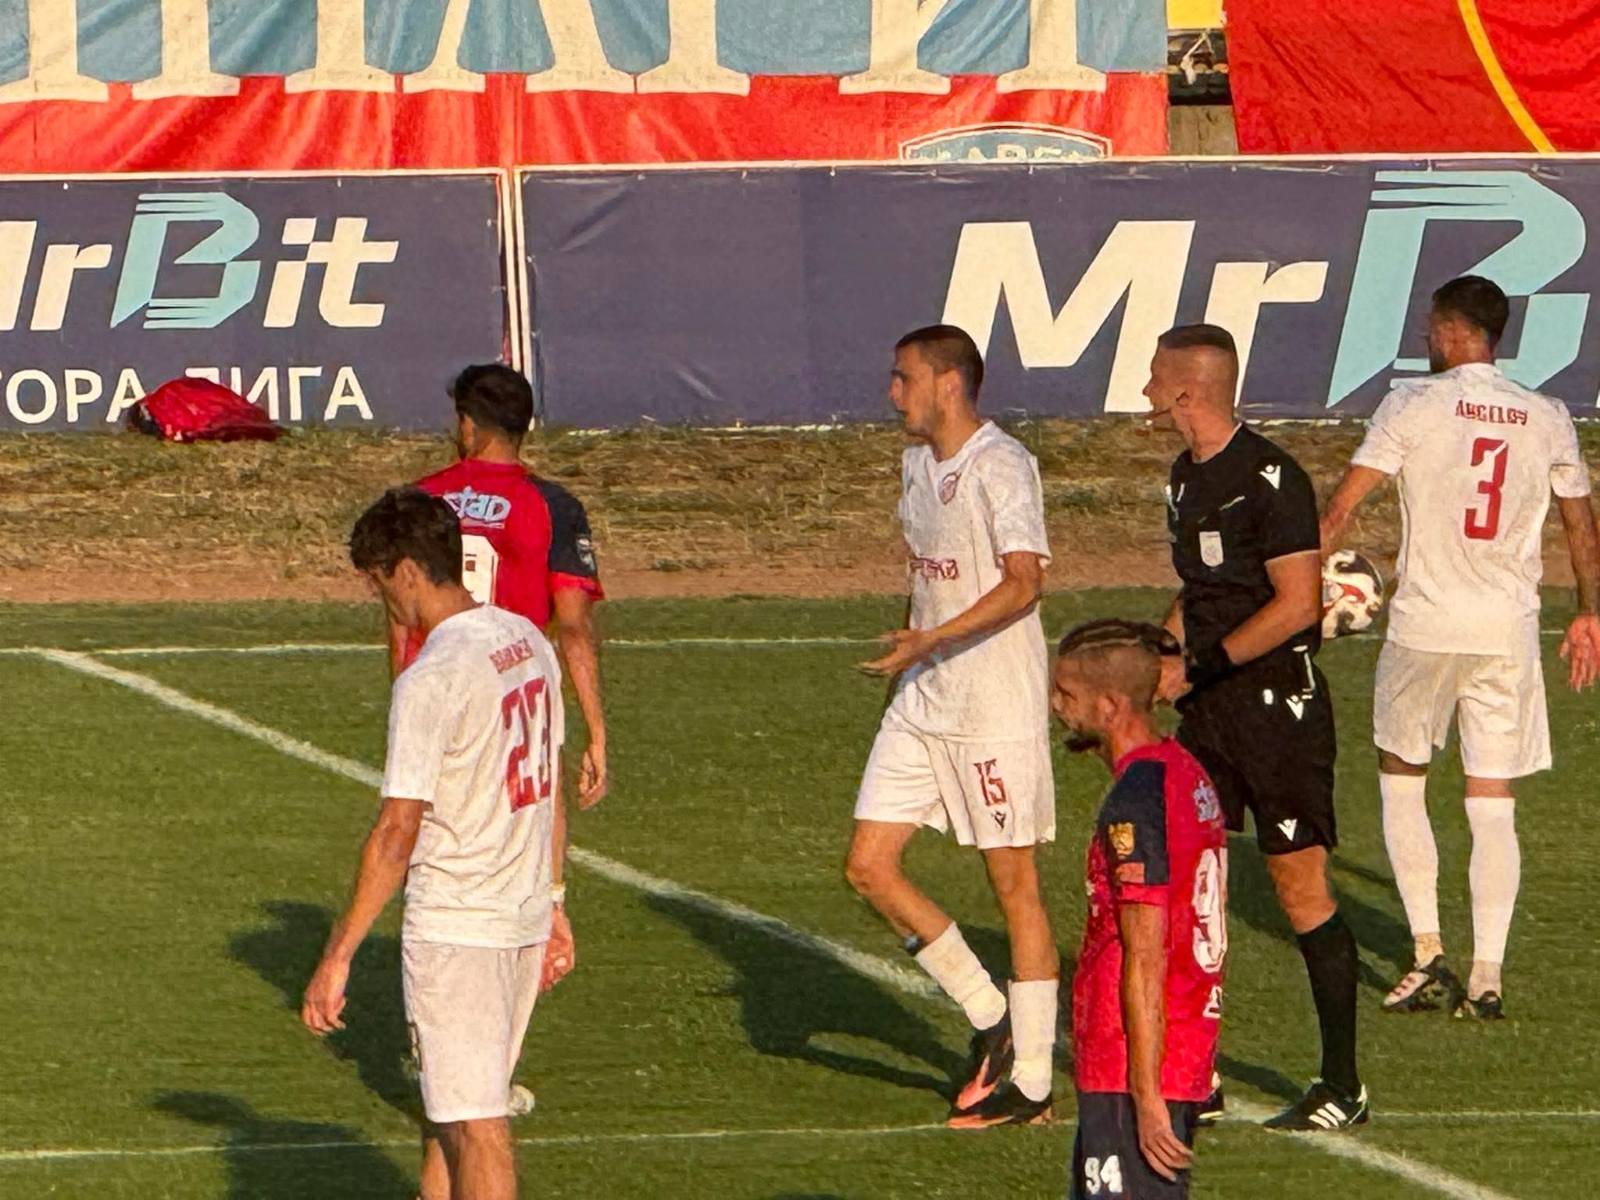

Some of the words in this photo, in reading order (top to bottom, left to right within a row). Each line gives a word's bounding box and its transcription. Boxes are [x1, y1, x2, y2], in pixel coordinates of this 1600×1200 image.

[0, 192, 399, 330] rBit
[941, 170, 1600, 413] MrB
[0, 368, 147, 423] ОРА
[1464, 437, 1509, 541] 3
[973, 758, 1007, 807] 15
[1084, 1154, 1123, 1195] 94
